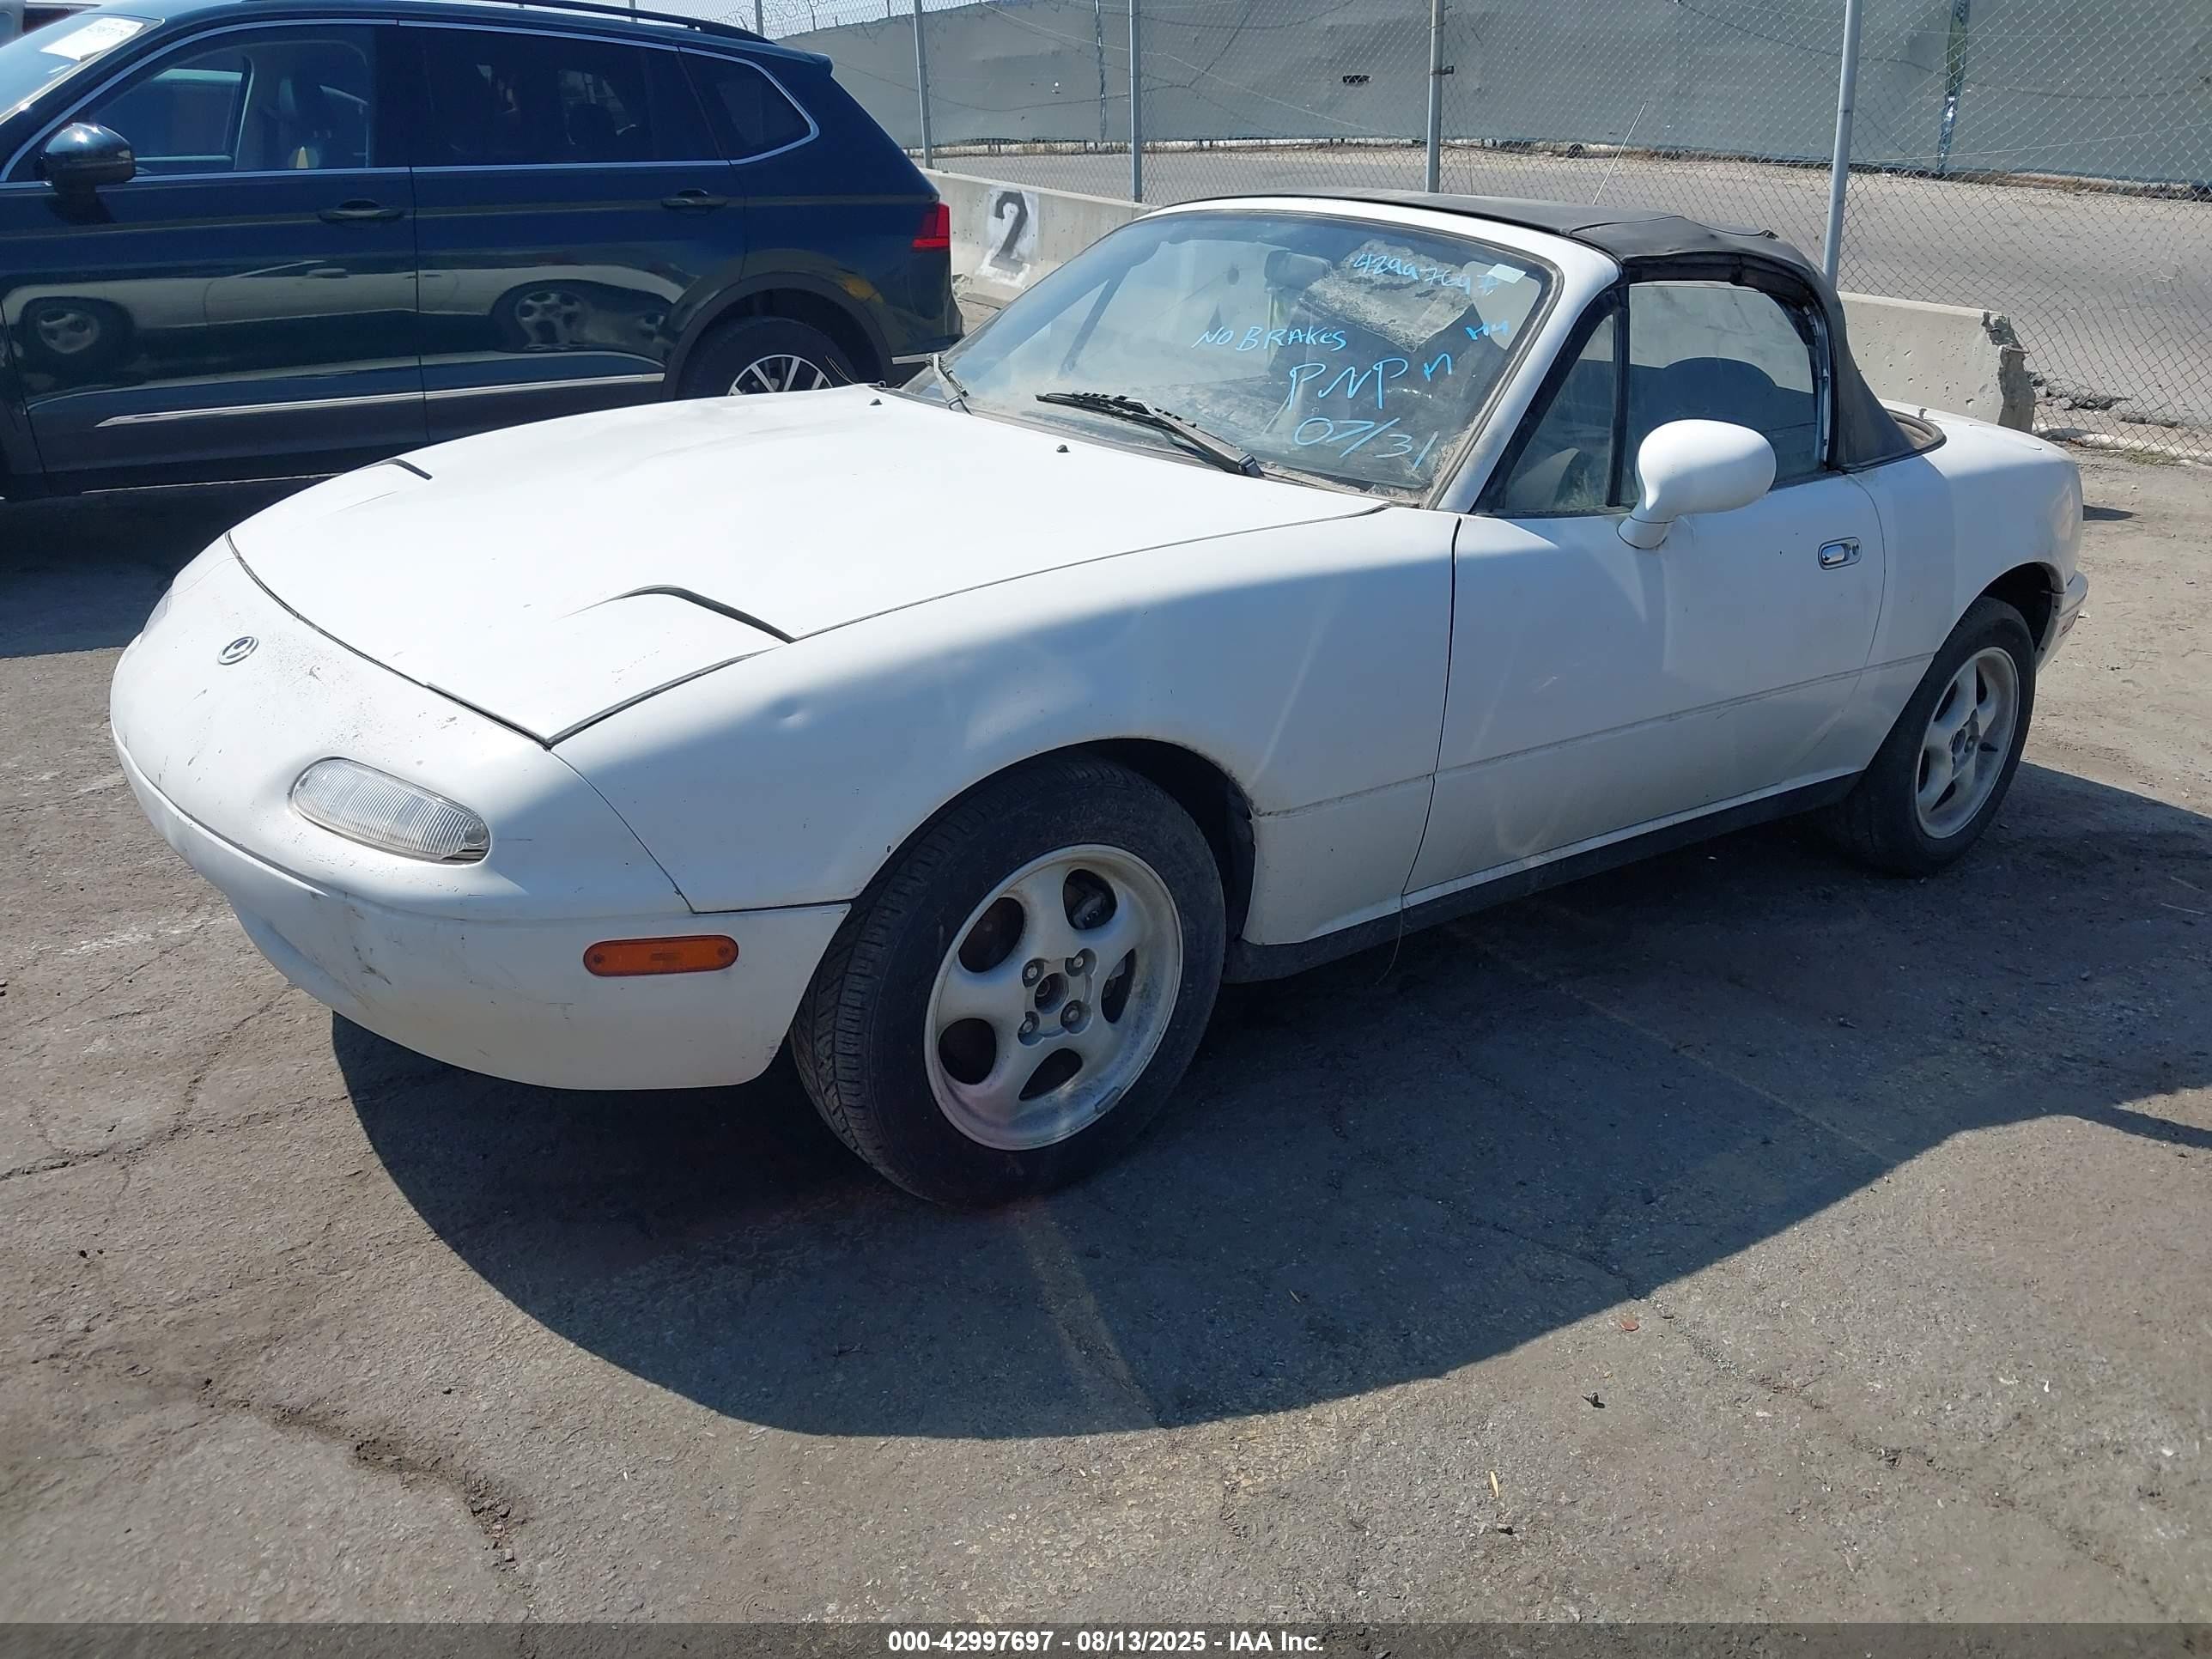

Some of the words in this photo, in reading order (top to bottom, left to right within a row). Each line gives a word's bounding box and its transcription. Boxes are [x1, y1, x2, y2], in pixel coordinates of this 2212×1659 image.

[988, 191, 1029, 275] 2
[1191, 325, 1235, 349] NO
[1294, 417, 1439, 471] 07/31
